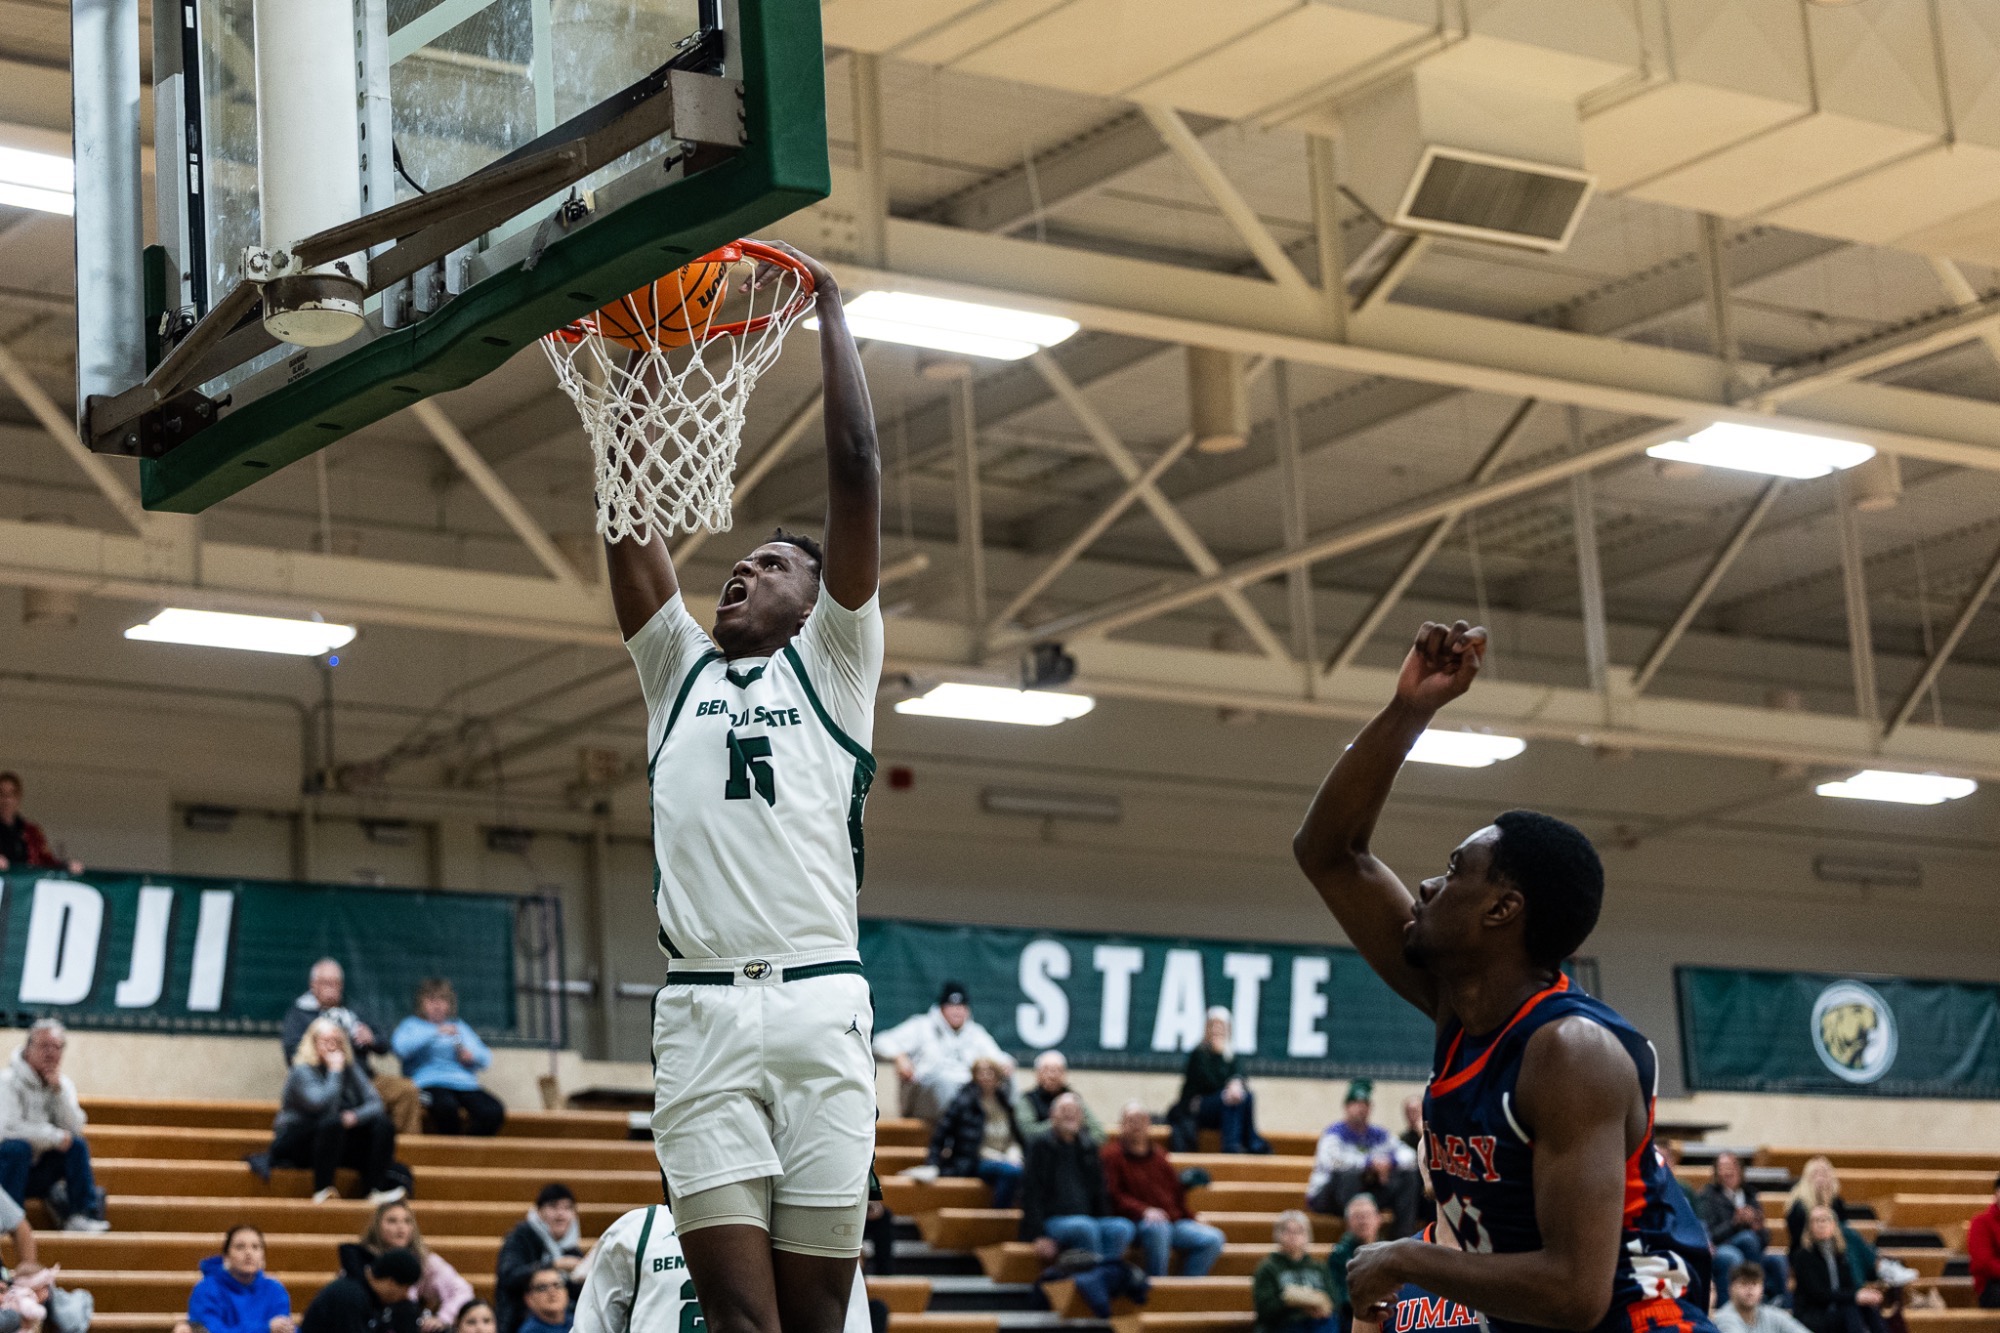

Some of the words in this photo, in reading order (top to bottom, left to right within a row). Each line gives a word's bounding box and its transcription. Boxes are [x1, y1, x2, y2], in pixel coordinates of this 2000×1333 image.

[753, 705, 802, 728] SATE
[724, 729, 776, 808] 15
[0, 876, 235, 1013] DJI
[1016, 939, 1331, 1058] STATE
[653, 1255, 687, 1273] BEM
[1394, 1296, 1490, 1333] UMA
